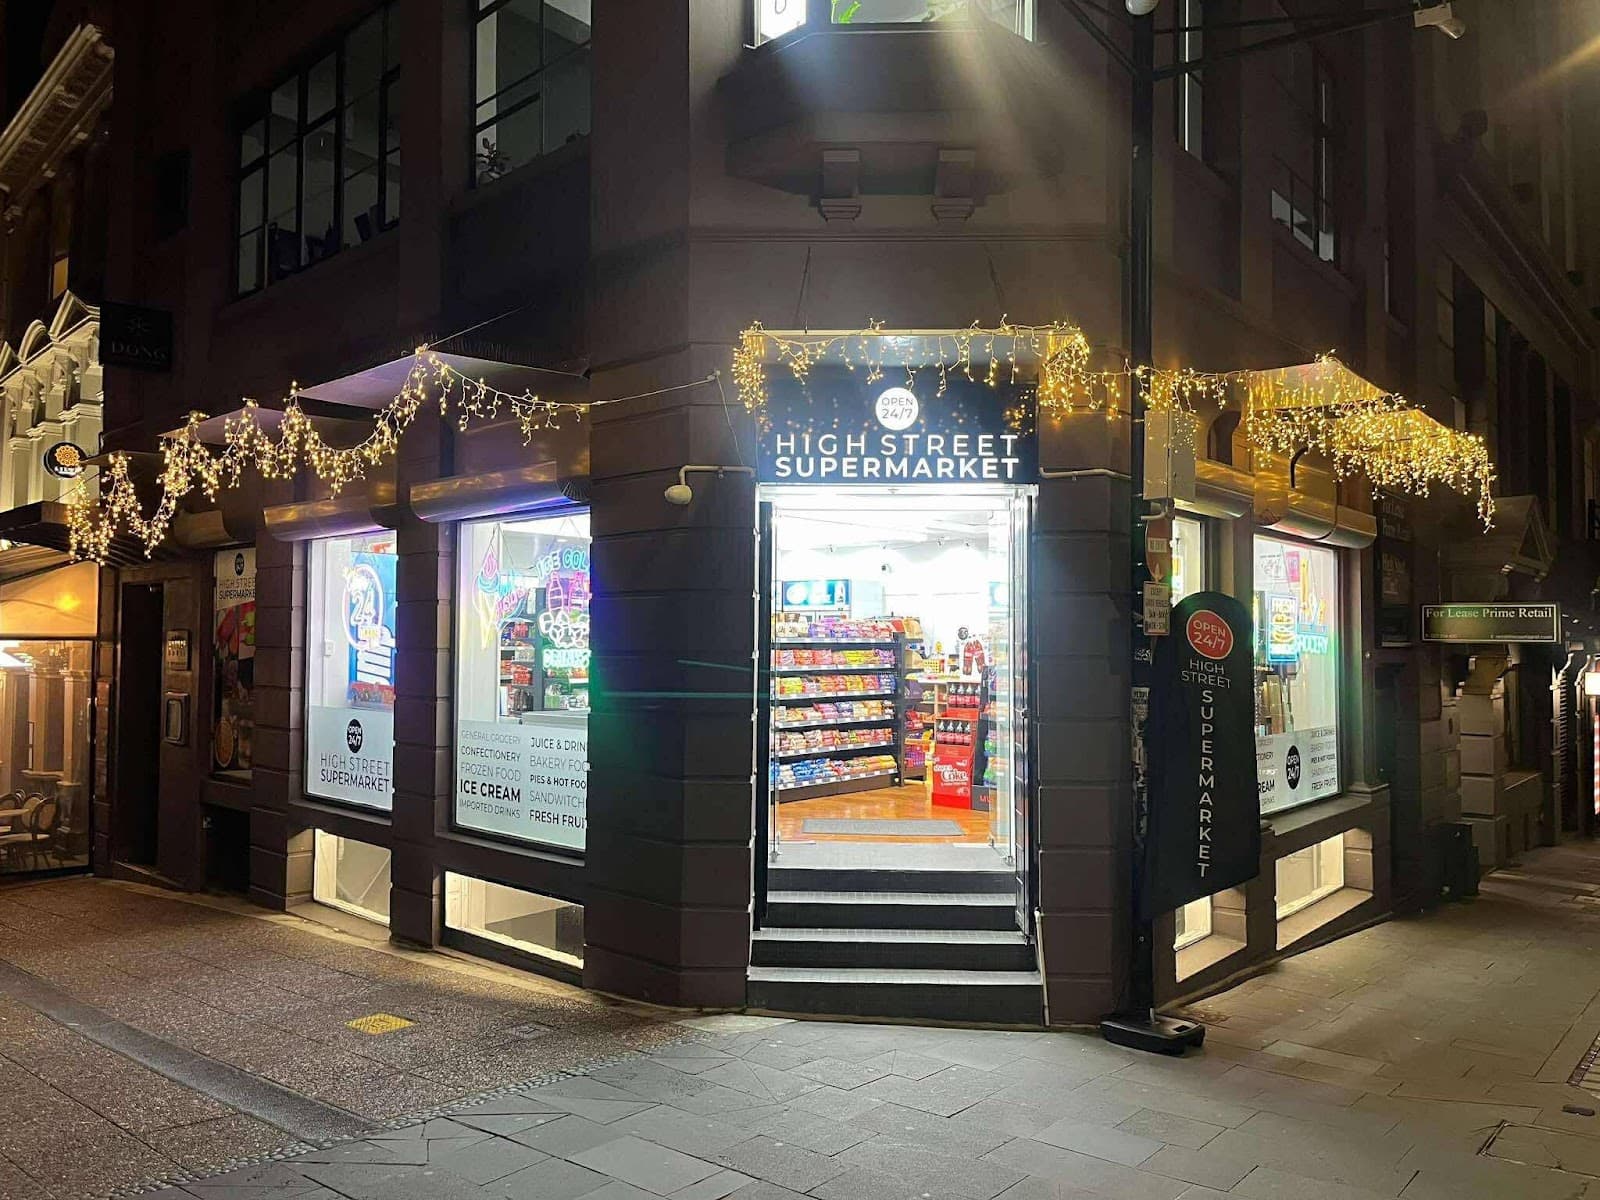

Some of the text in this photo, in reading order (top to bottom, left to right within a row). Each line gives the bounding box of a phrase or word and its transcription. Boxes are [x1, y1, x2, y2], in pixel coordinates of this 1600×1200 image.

[881, 397, 913, 406] OPEN
[881, 408, 913, 420] 24/7
[776, 433, 1018, 457] HIGH STREET
[775, 457, 1020, 478] SUPERMARKET
[1425, 607, 1552, 618] For Lease Prime Retail
[1193, 619, 1226, 638] OPEN
[1193, 632, 1226, 650] 24/7
[1189, 658, 1225, 675] HIGH
[1181, 670, 1232, 689] STREET
[348, 726, 362, 735] OPEN
[461, 730, 521, 745] GENERAL GROCERY
[348, 734, 362, 747] 24/7
[530, 737, 586, 752] JUICE & DRIN
[461, 746, 521, 762] CONFECTIONERY
[530, 755, 566, 769] BAKERY
[1287, 754, 1299, 765] OPEN
[320, 753, 390, 776] HIGH STREET
[461, 762, 522, 782] FROZEN FOOD
[1287, 765, 1299, 780] 24/7
[320, 769, 390, 792] SUPERMARKET
[530, 774, 545, 784] PIES
[554, 777, 568, 787] HOT
[941, 768, 968, 783] Coke
[1197, 690, 1215, 877] SUPERMARKET
[460, 779, 521, 803] ICE CREAM
[460, 800, 521, 819] IMPORTED DRINKS
[529, 809, 559, 825] FRESH
